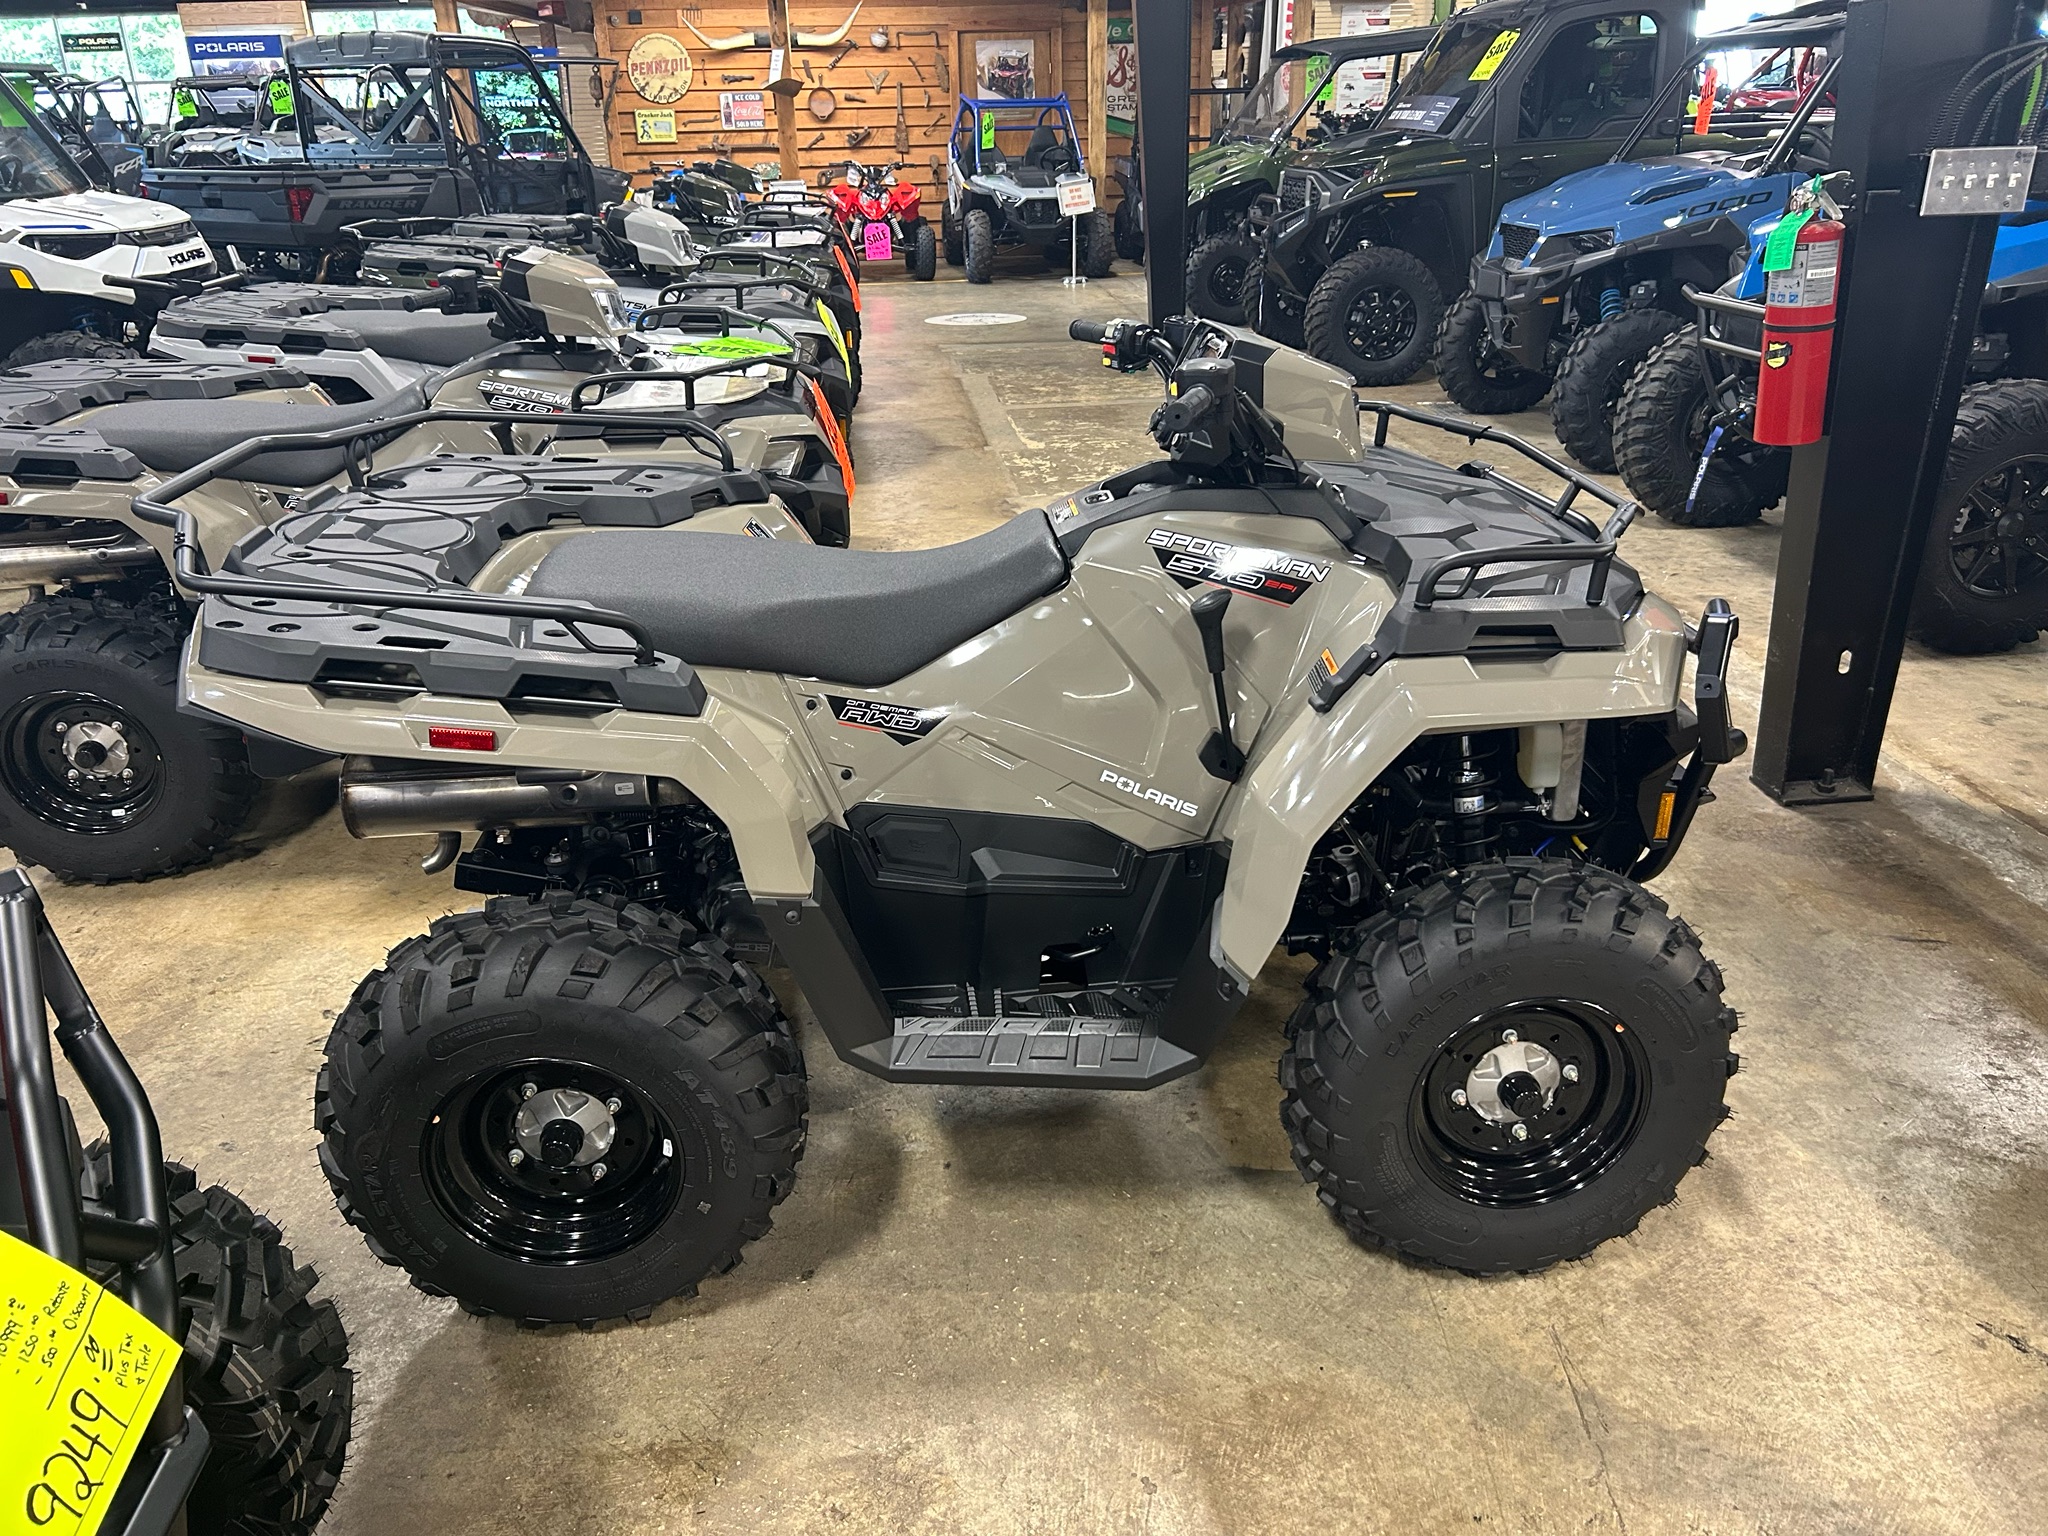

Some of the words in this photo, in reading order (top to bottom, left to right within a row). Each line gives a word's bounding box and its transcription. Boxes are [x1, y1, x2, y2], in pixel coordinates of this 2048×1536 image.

[78, 37, 119, 45] POLARIS
[194, 41, 265, 53] POLARIS
[1485, 37, 1515, 60] SALE
[630, 57, 691, 77] PENNZOIL
[178, 94, 193, 106] SALE
[272, 87, 290, 102] SALE
[1107, 95, 1136, 103] GRE
[1107, 104, 1137, 112] STAM
[983, 118, 994, 135] SALE
[113, 154, 144, 178] RZR
[338, 199, 418, 209] RANGER
[866, 229, 889, 246] SALE
[167, 247, 206, 268] POLARIS
[477, 379, 573, 407] SPORTSM
[490, 395, 554, 414] 570
[1689, 456, 1709, 500] POLARIS
[1145, 528, 1332, 583] SPORMAN
[1165, 553, 1266, 590] 570
[839, 706, 922, 730] AWD
[870, 703, 921, 717] DEMAN
[1099, 769, 1199, 817] POLARIS
[119, 1332, 134, 1355] Tax
